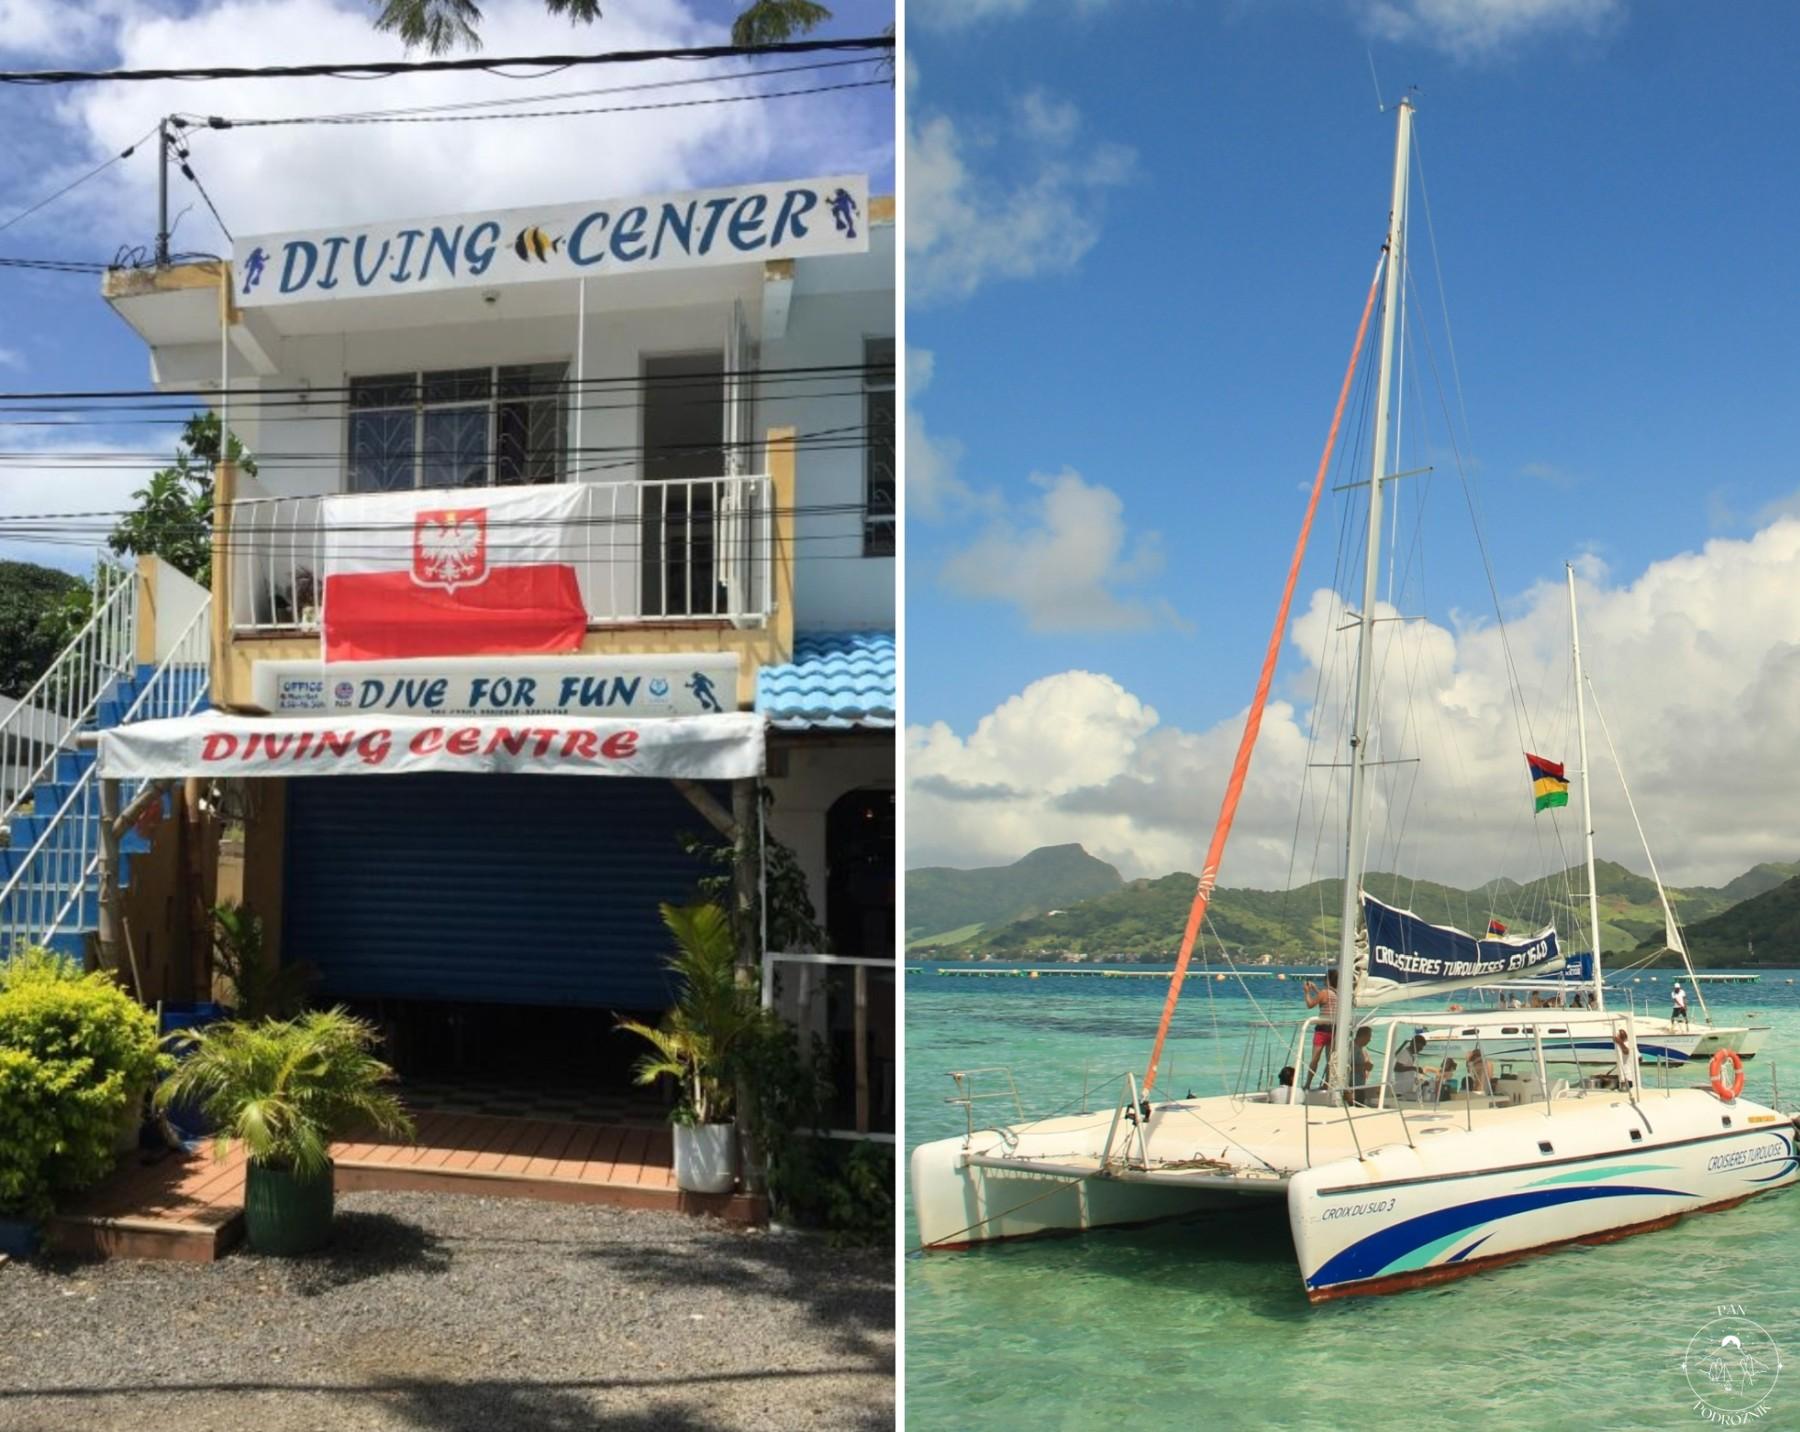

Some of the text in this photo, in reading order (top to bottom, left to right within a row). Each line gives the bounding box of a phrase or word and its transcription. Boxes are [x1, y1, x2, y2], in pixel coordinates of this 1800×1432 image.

[279, 188, 819, 294] DIVING CENTER
[358, 676, 642, 709] DIVE FOR FUN
[201, 727, 640, 765] DIVING CENTRE
[1321, 1198, 1396, 1221] CROIX DU SUD 3
